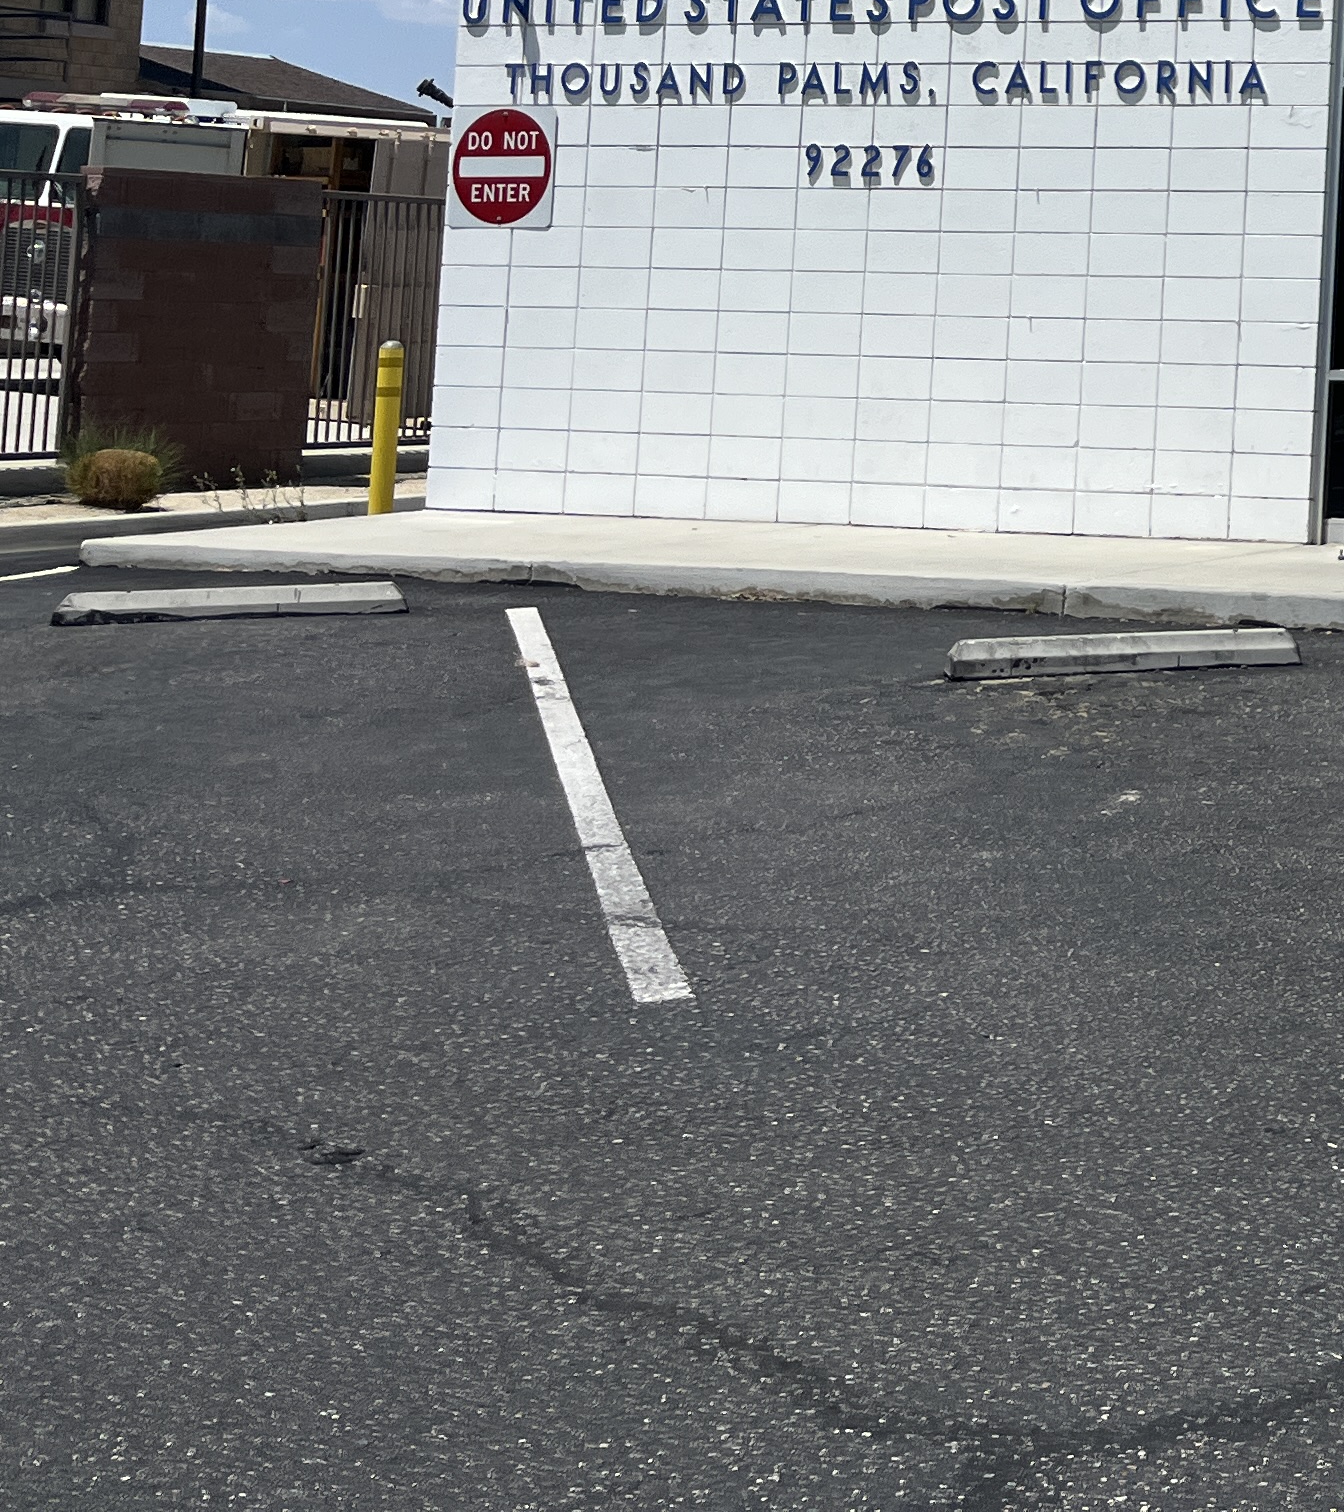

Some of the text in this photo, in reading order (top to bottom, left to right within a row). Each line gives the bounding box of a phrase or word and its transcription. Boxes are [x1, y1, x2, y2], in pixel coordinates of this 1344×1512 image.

[505, 59, 1266, 97] THOUSAND PALMS, CALIFORNIA
[467, 130, 540, 150] DO NOT
[805, 143, 933, 178] 92276
[470, 183, 531, 203] ENTER
